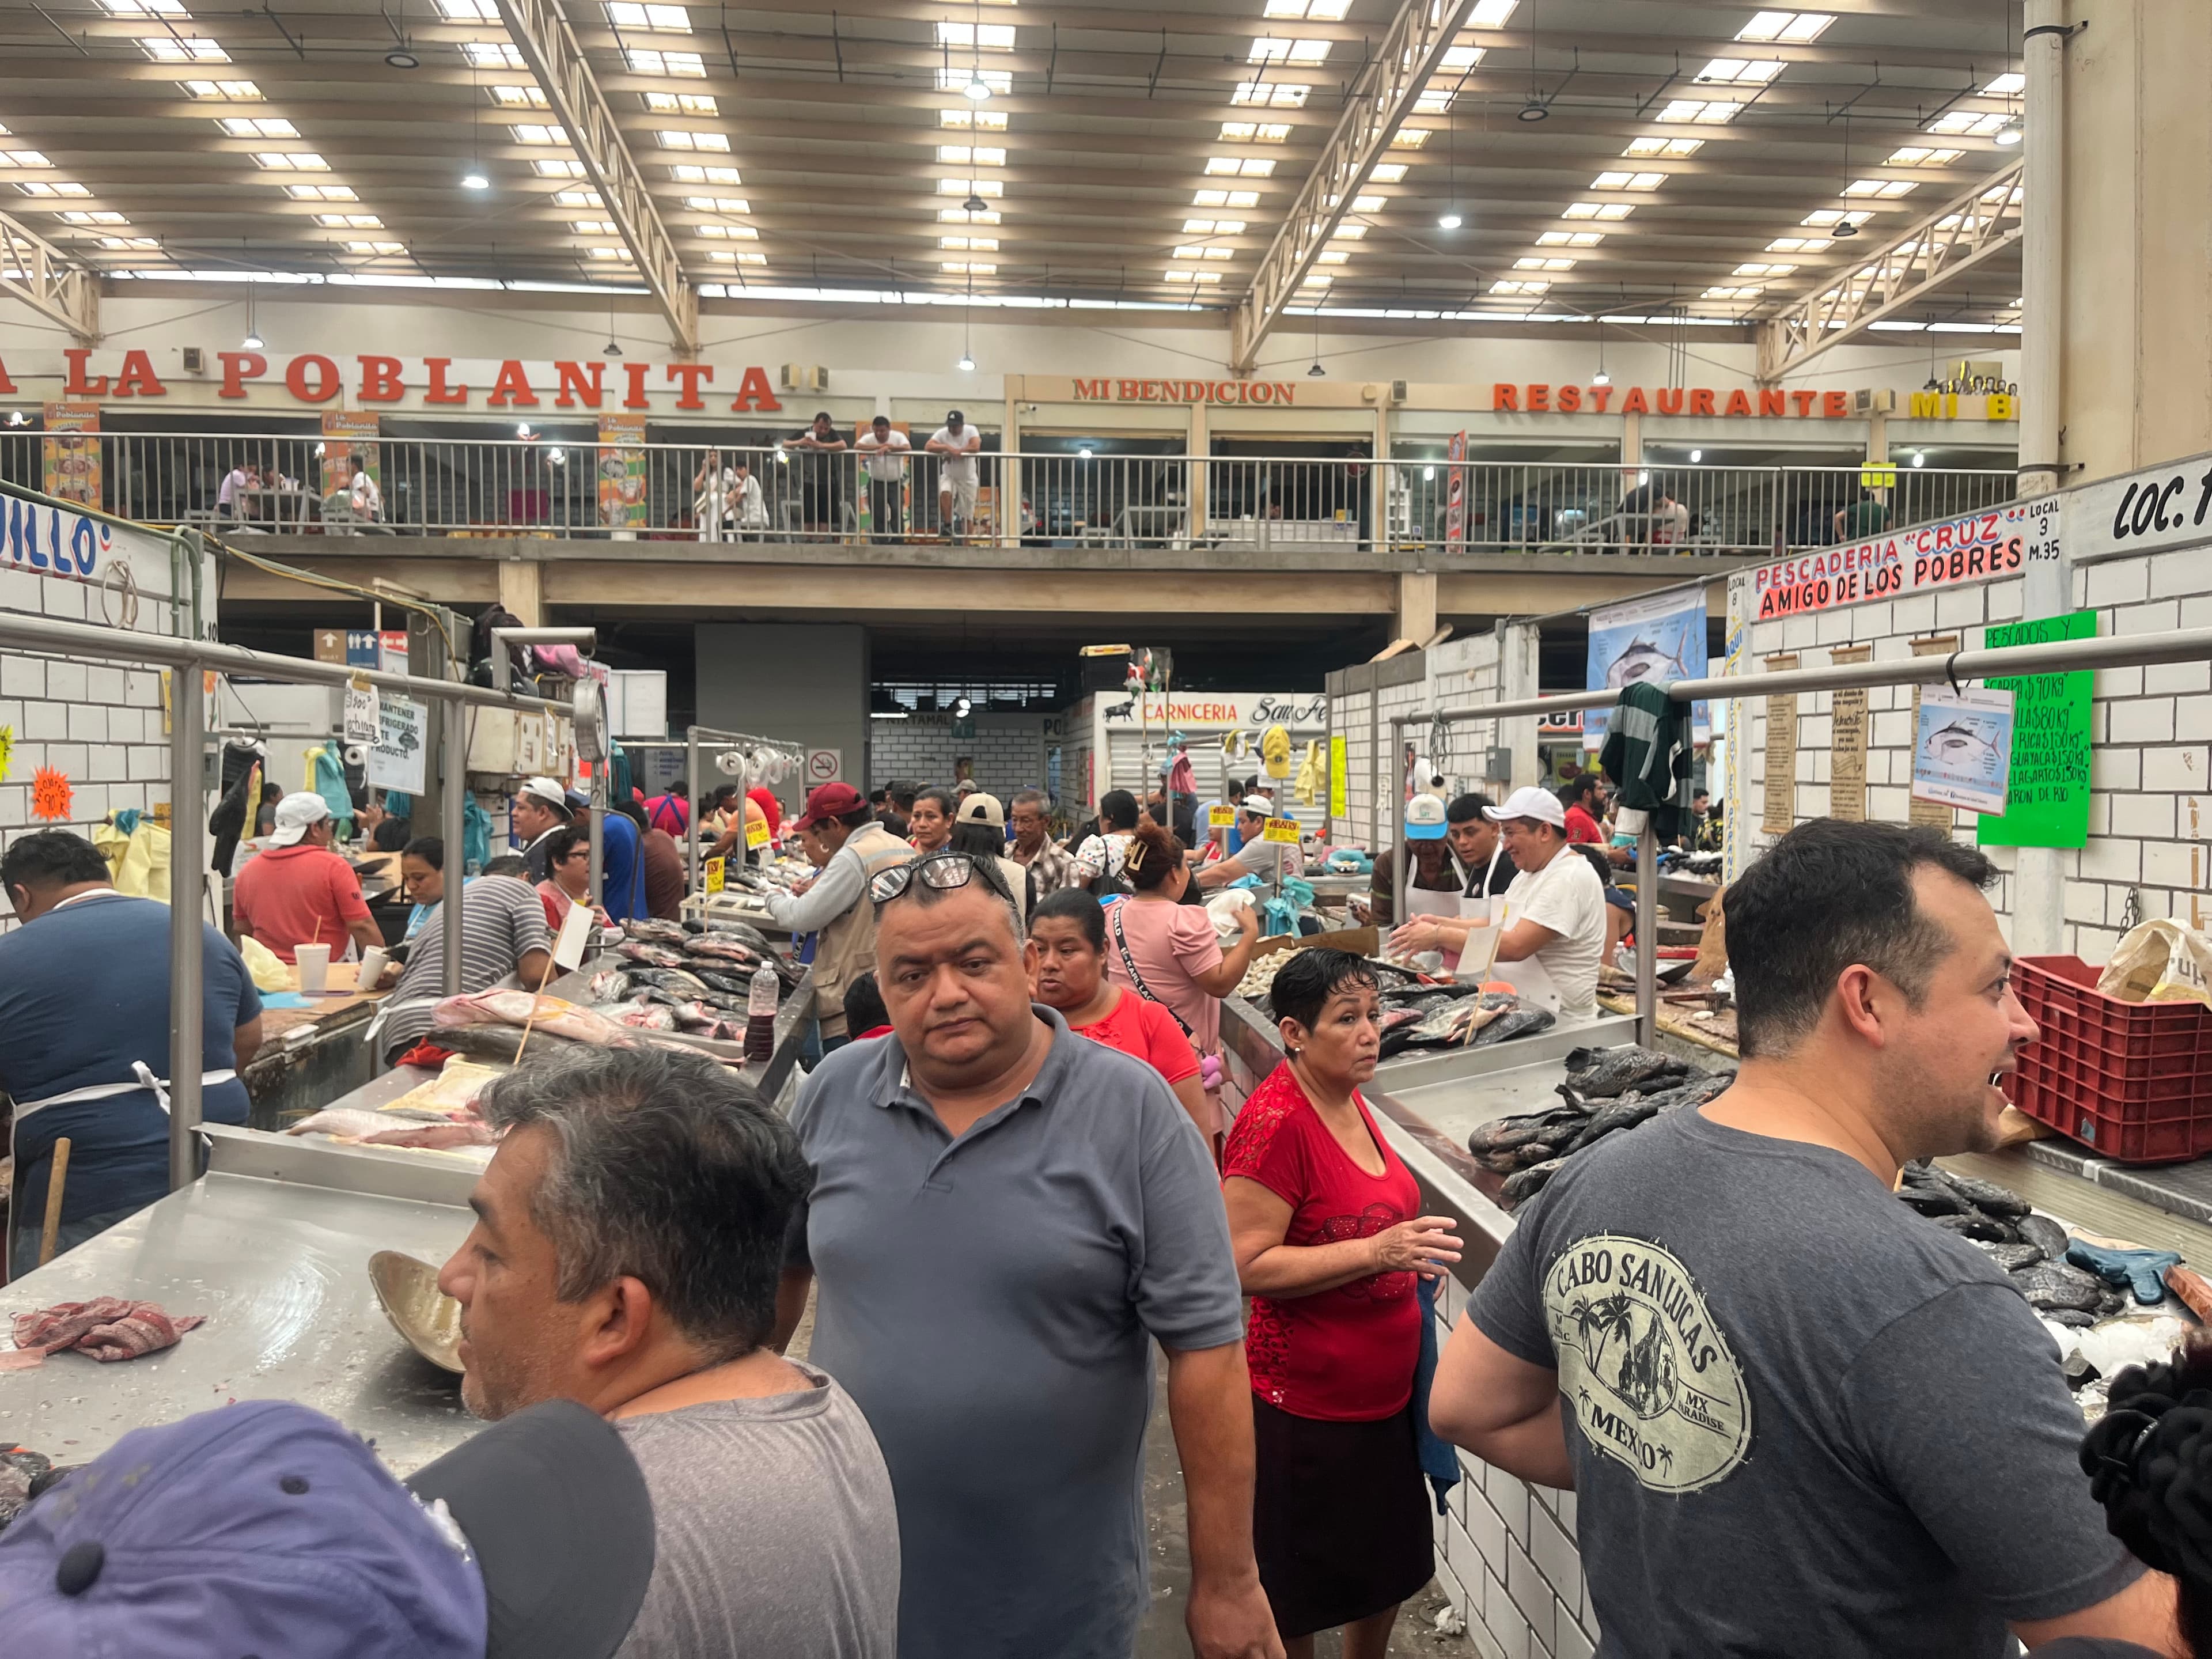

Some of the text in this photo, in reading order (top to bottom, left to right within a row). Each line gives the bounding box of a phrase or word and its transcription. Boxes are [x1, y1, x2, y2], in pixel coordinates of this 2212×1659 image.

[63, 349, 166, 396] LA
[218, 352, 782, 411] POBLANITA
[1073, 379, 1296, 405] MI BENDICION
[1493, 383, 1847, 417] RESTAURANTE
[1910, 392, 1957, 418] MI
[2030, 500, 2059, 518] LOCAL
[2113, 476, 2183, 539] LOC.
[2040, 517, 2048, 536] 3
[2029, 539, 2060, 561] M.35
[1756, 540, 1898, 593] PESCADERIA
[1761, 539, 2021, 617] AMIGO DE LOS POBRES
[1729, 576, 1745, 591] LOCAL
[1732, 592, 1737, 606] 8
[1725, 628, 1742, 660] AQUI
[1985, 618, 2070, 649] PESCADOS Y
[1143, 703, 1237, 720] CARNICERIA
[1252, 697, 1293, 722] San
[379, 714, 418, 735] EFRIGERADO
[1558, 1249, 1718, 1373] CABO SAN LUCAS
[1686, 1390, 1709, 1414] MX
